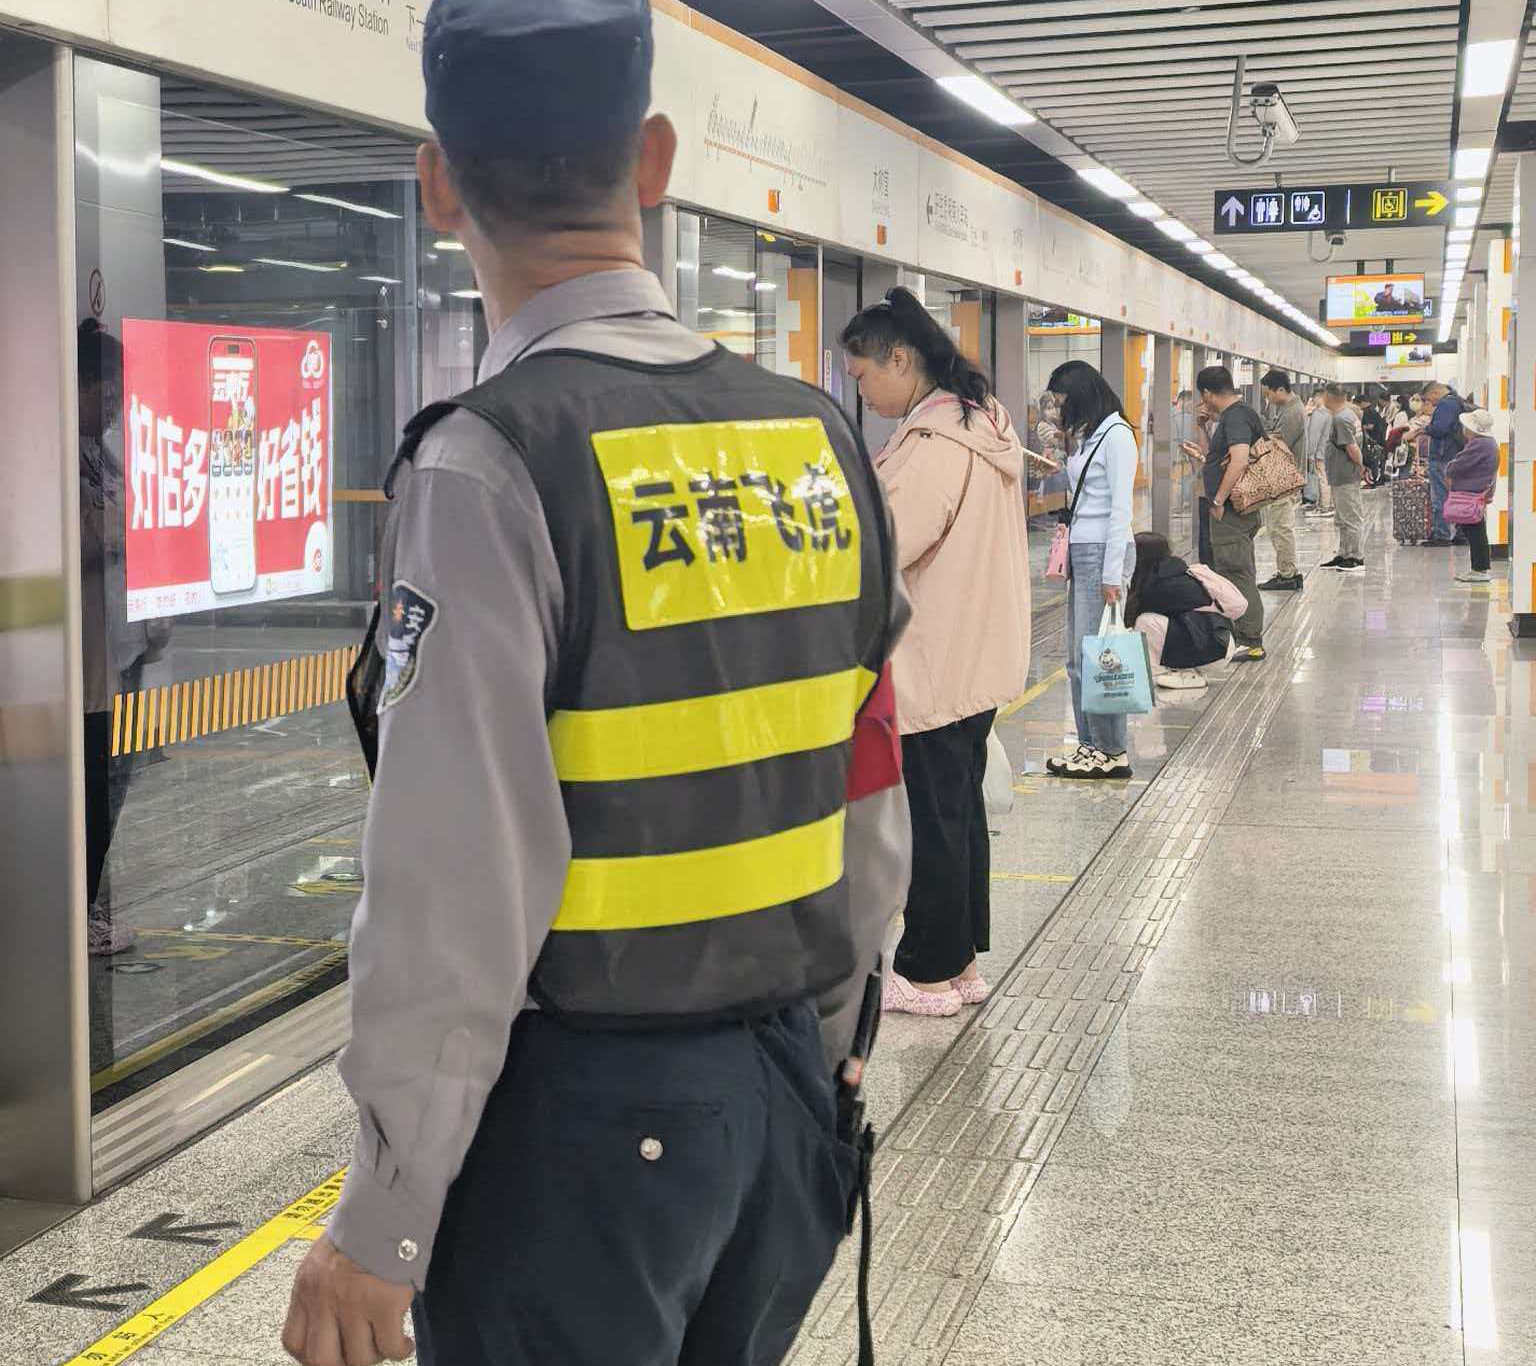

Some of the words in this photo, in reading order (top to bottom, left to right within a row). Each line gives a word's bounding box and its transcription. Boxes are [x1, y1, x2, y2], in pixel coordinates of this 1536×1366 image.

[358, 4, 390, 36] Station
[257, 397, 322, 522] 好省钱
